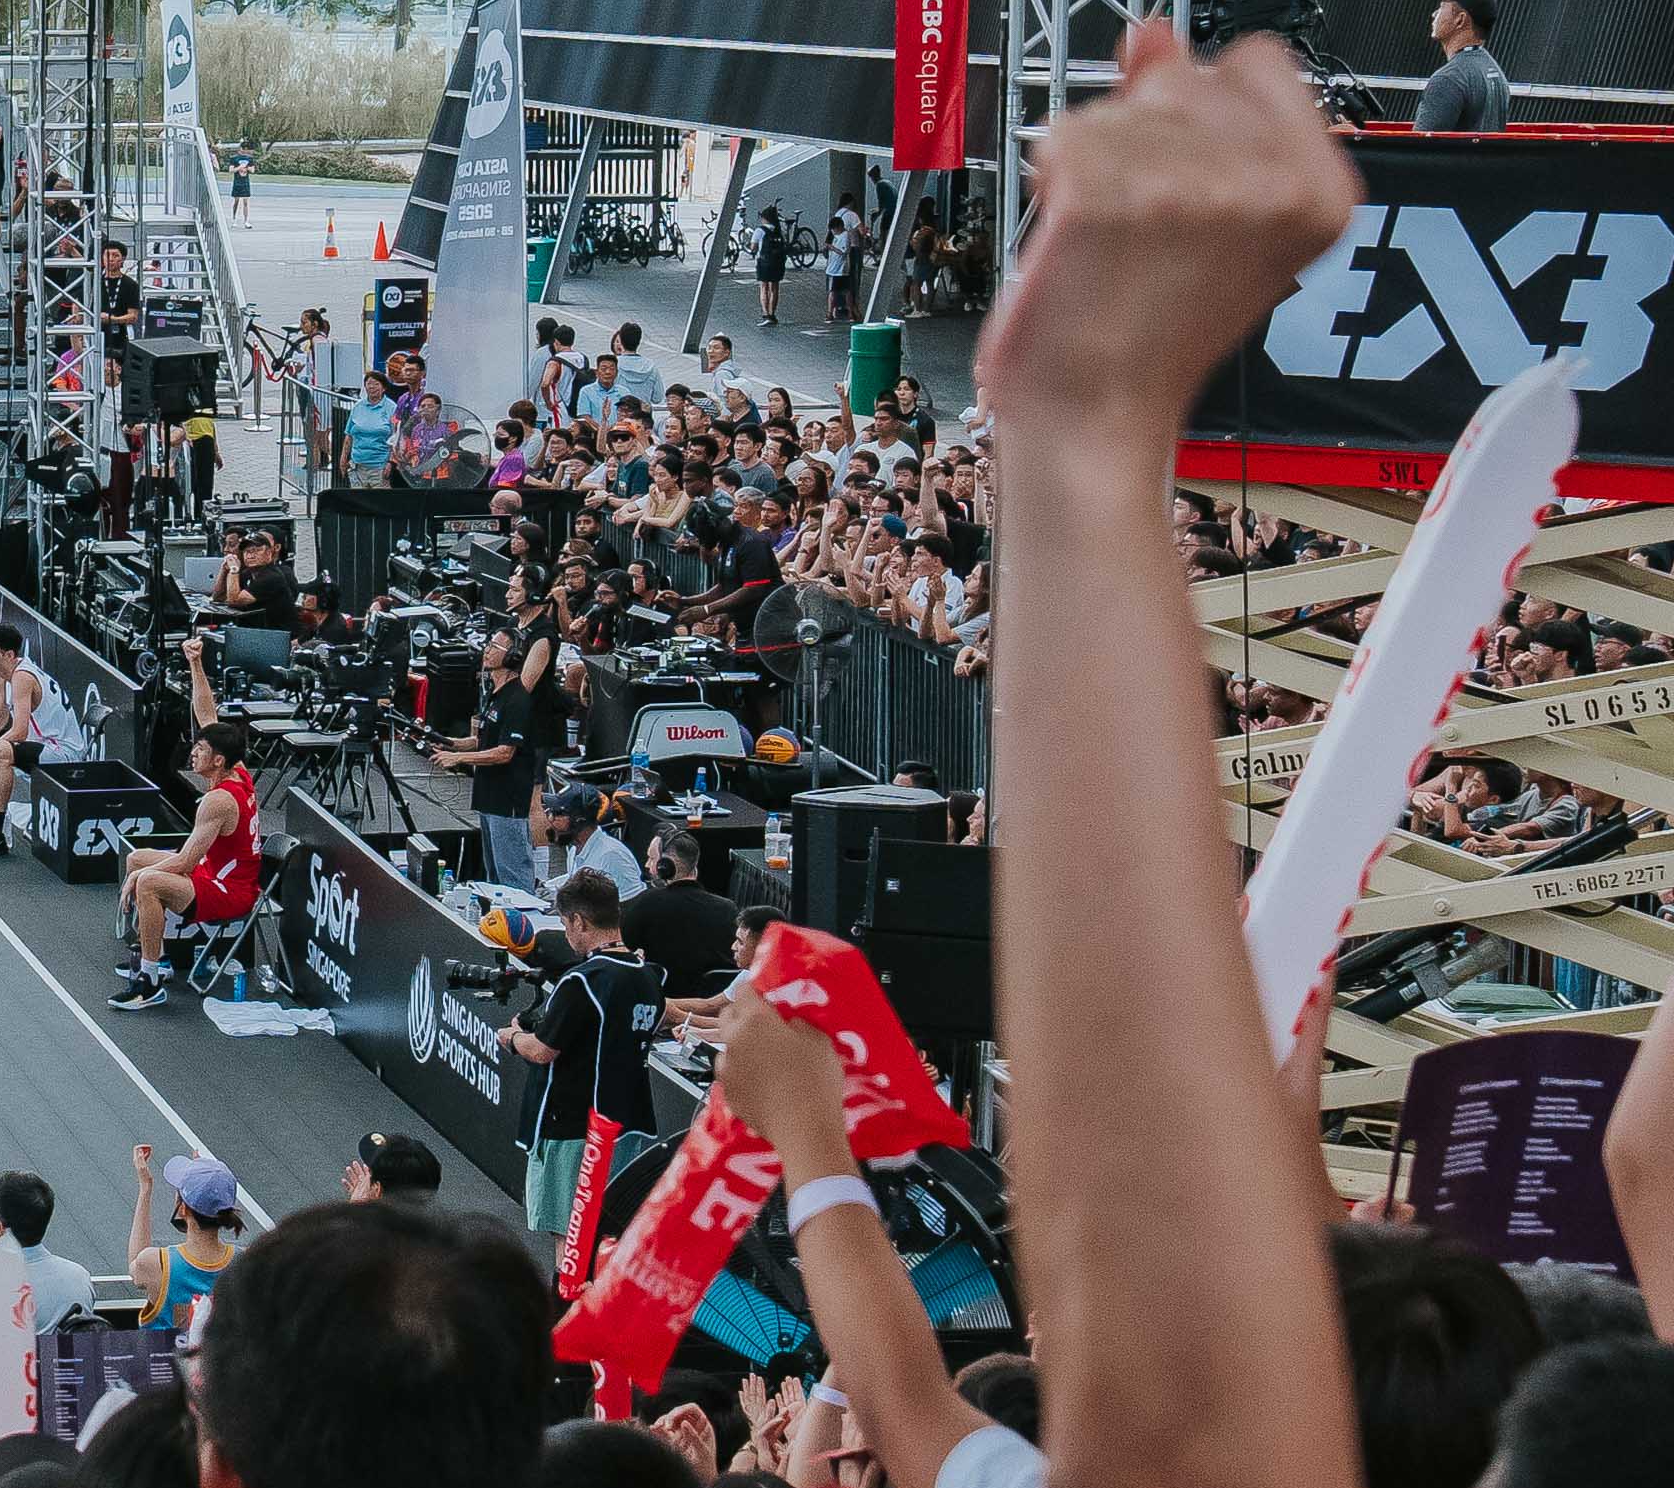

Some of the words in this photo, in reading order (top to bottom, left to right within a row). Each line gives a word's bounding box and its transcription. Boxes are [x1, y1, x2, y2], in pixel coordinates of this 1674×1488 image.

[915, 50, 939, 134] square
[1378, 462, 1425, 486] SWL
[666, 726, 727, 742] Wilson
[1545, 703, 1576, 728] SL
[307, 852, 361, 956] Sport
[1625, 864, 1665, 887] 2277
[306, 938, 351, 1003] SINGAPORE
[441, 990, 500, 1064] SINGAPORE
[438, 1029, 477, 1087] SPORTS
[477, 1064, 500, 1106] HUB
[560, 1131, 603, 1278] #OneTeamSG
